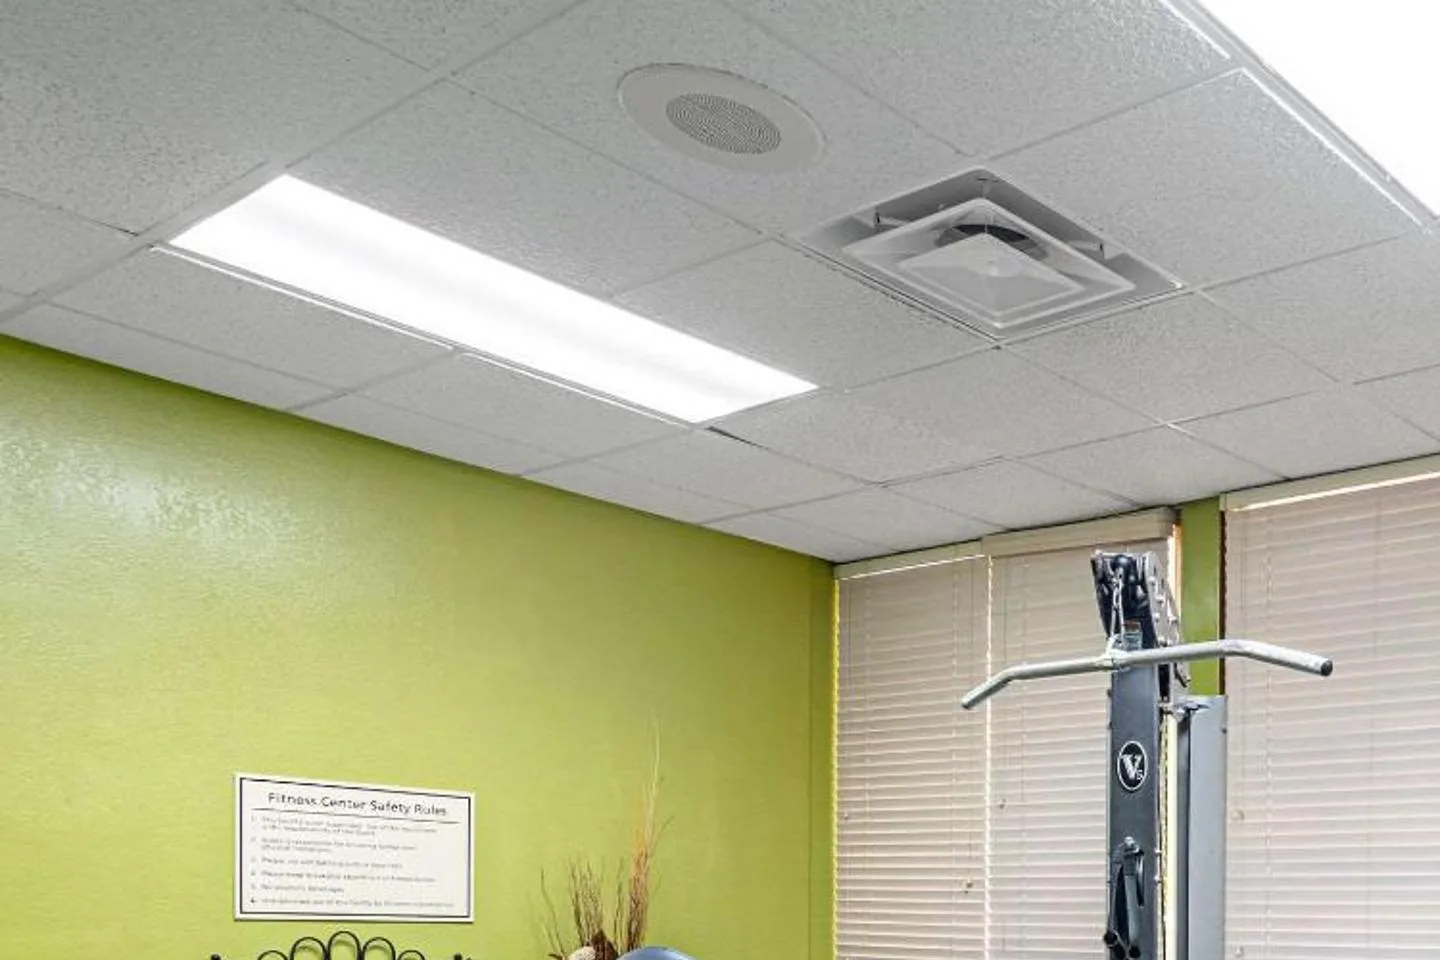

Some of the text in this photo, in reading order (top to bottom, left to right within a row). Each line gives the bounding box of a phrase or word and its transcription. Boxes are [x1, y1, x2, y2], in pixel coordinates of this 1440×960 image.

[268, 792, 447, 817] Fitness Center Safety Rules
